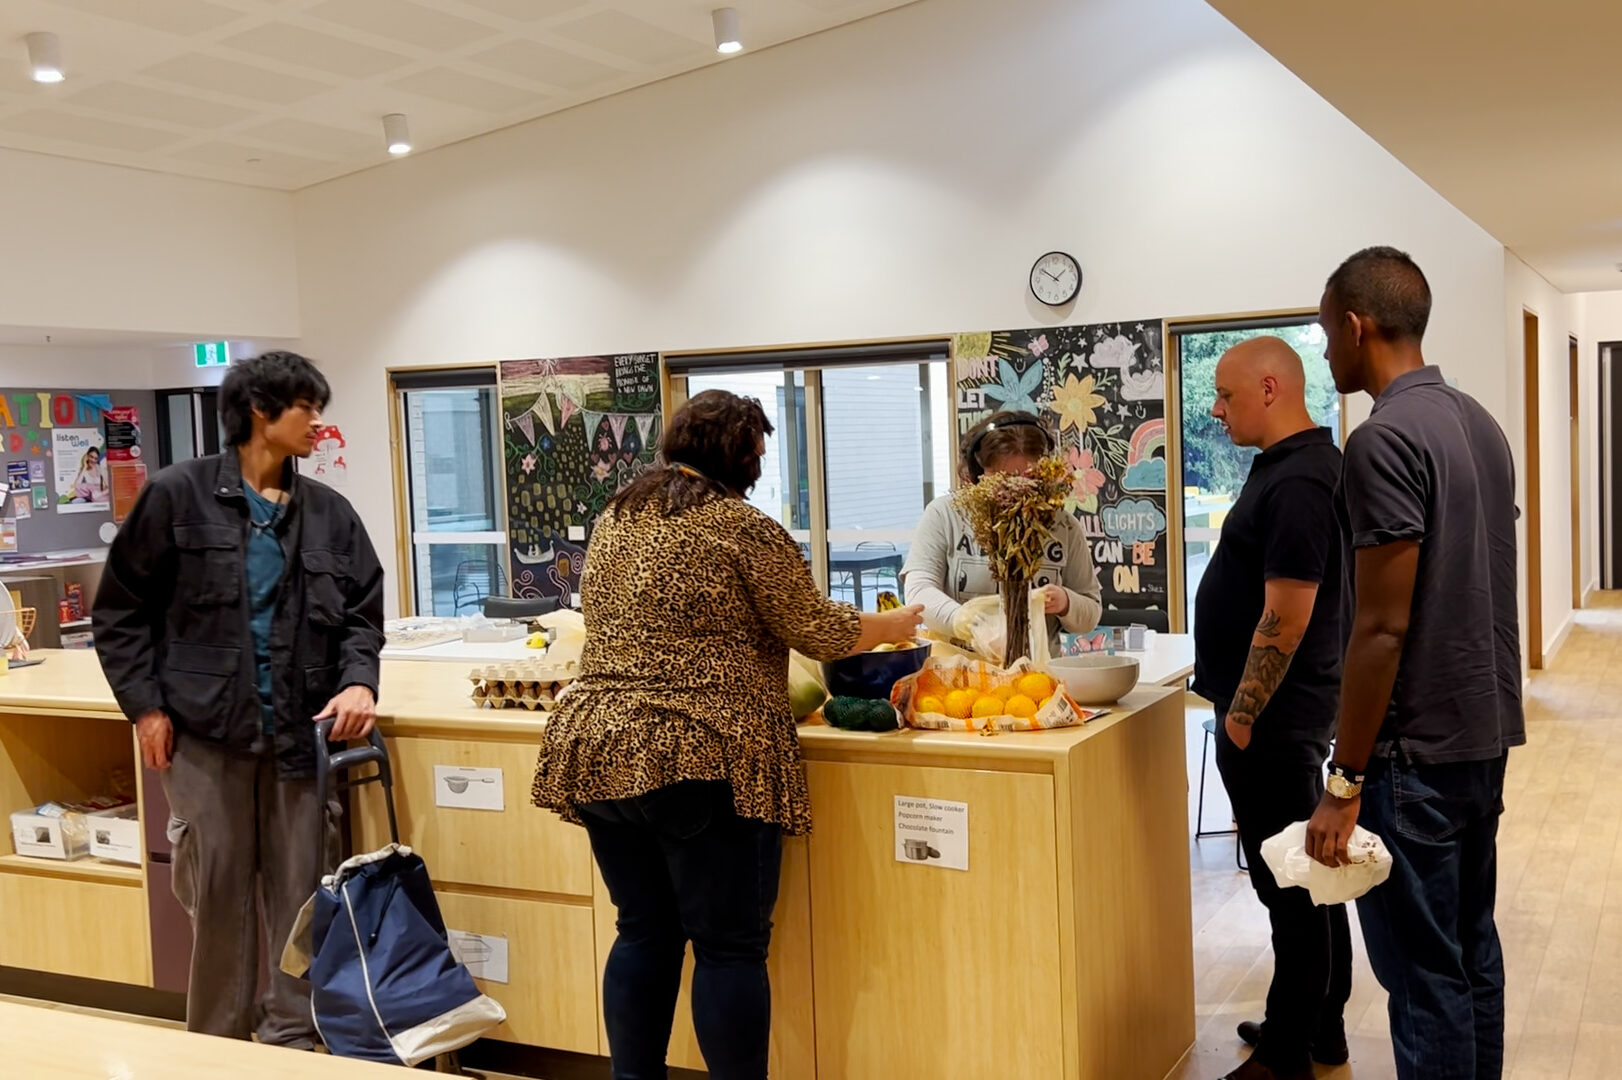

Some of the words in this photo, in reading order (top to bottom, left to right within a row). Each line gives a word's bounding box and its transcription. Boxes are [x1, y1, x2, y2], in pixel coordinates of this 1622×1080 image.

[957, 387, 988, 409] LET
[1107, 512, 1155, 531] LIGHTS
[1094, 540, 1124, 564] CAN
[1132, 541, 1155, 566] BE
[898, 800, 915, 808] Large
[944, 805, 965, 813] cooker
[898, 811, 923, 819] Popcorn
[898, 823, 928, 831] Chocolate
[929, 826, 955, 834] fountain
